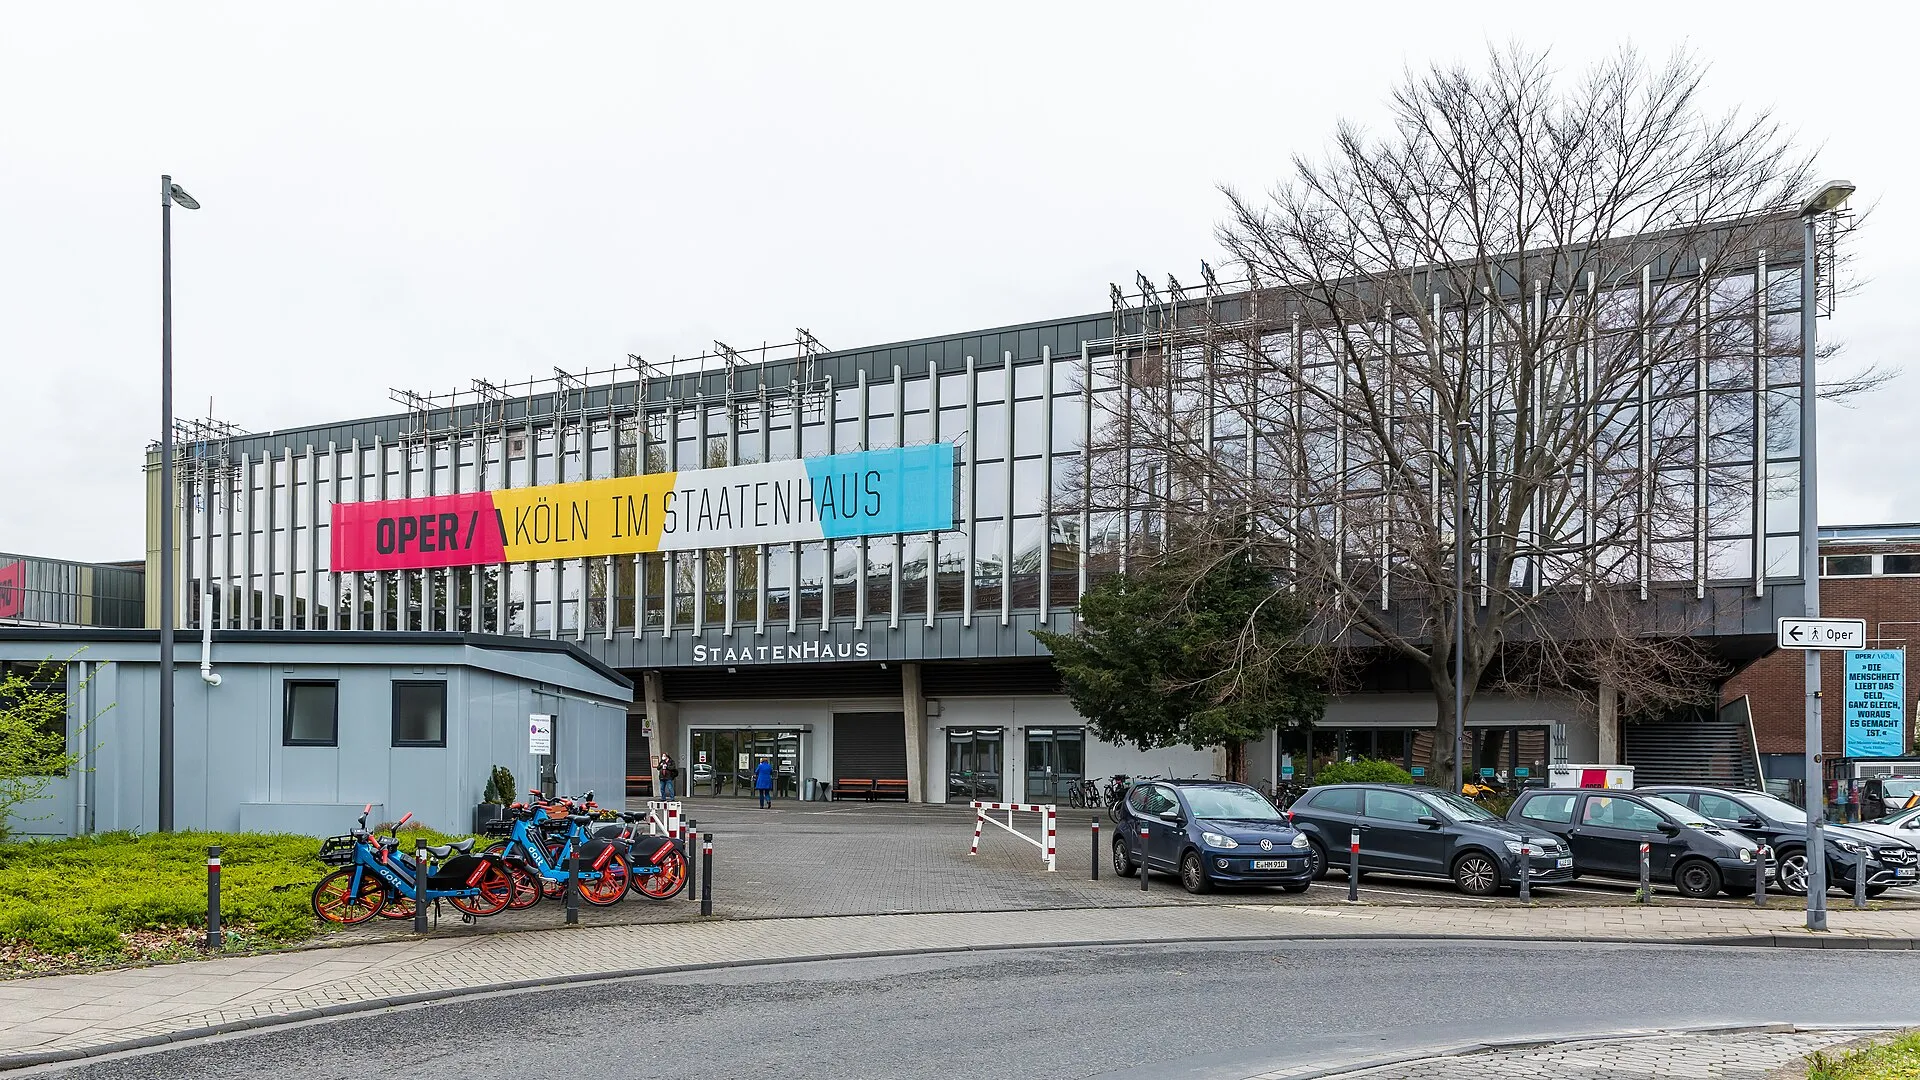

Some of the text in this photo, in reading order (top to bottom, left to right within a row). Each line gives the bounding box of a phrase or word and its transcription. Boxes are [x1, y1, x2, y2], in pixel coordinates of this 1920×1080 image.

[611, 494, 649, 538] IM
[663, 471, 881, 534] STAATENHAUS
[1827, 629, 1853, 641] Oper
[1864, 692, 1885, 700] GELD,
[529, 847, 544, 866] dott
[380, 869, 402, 888] dott
